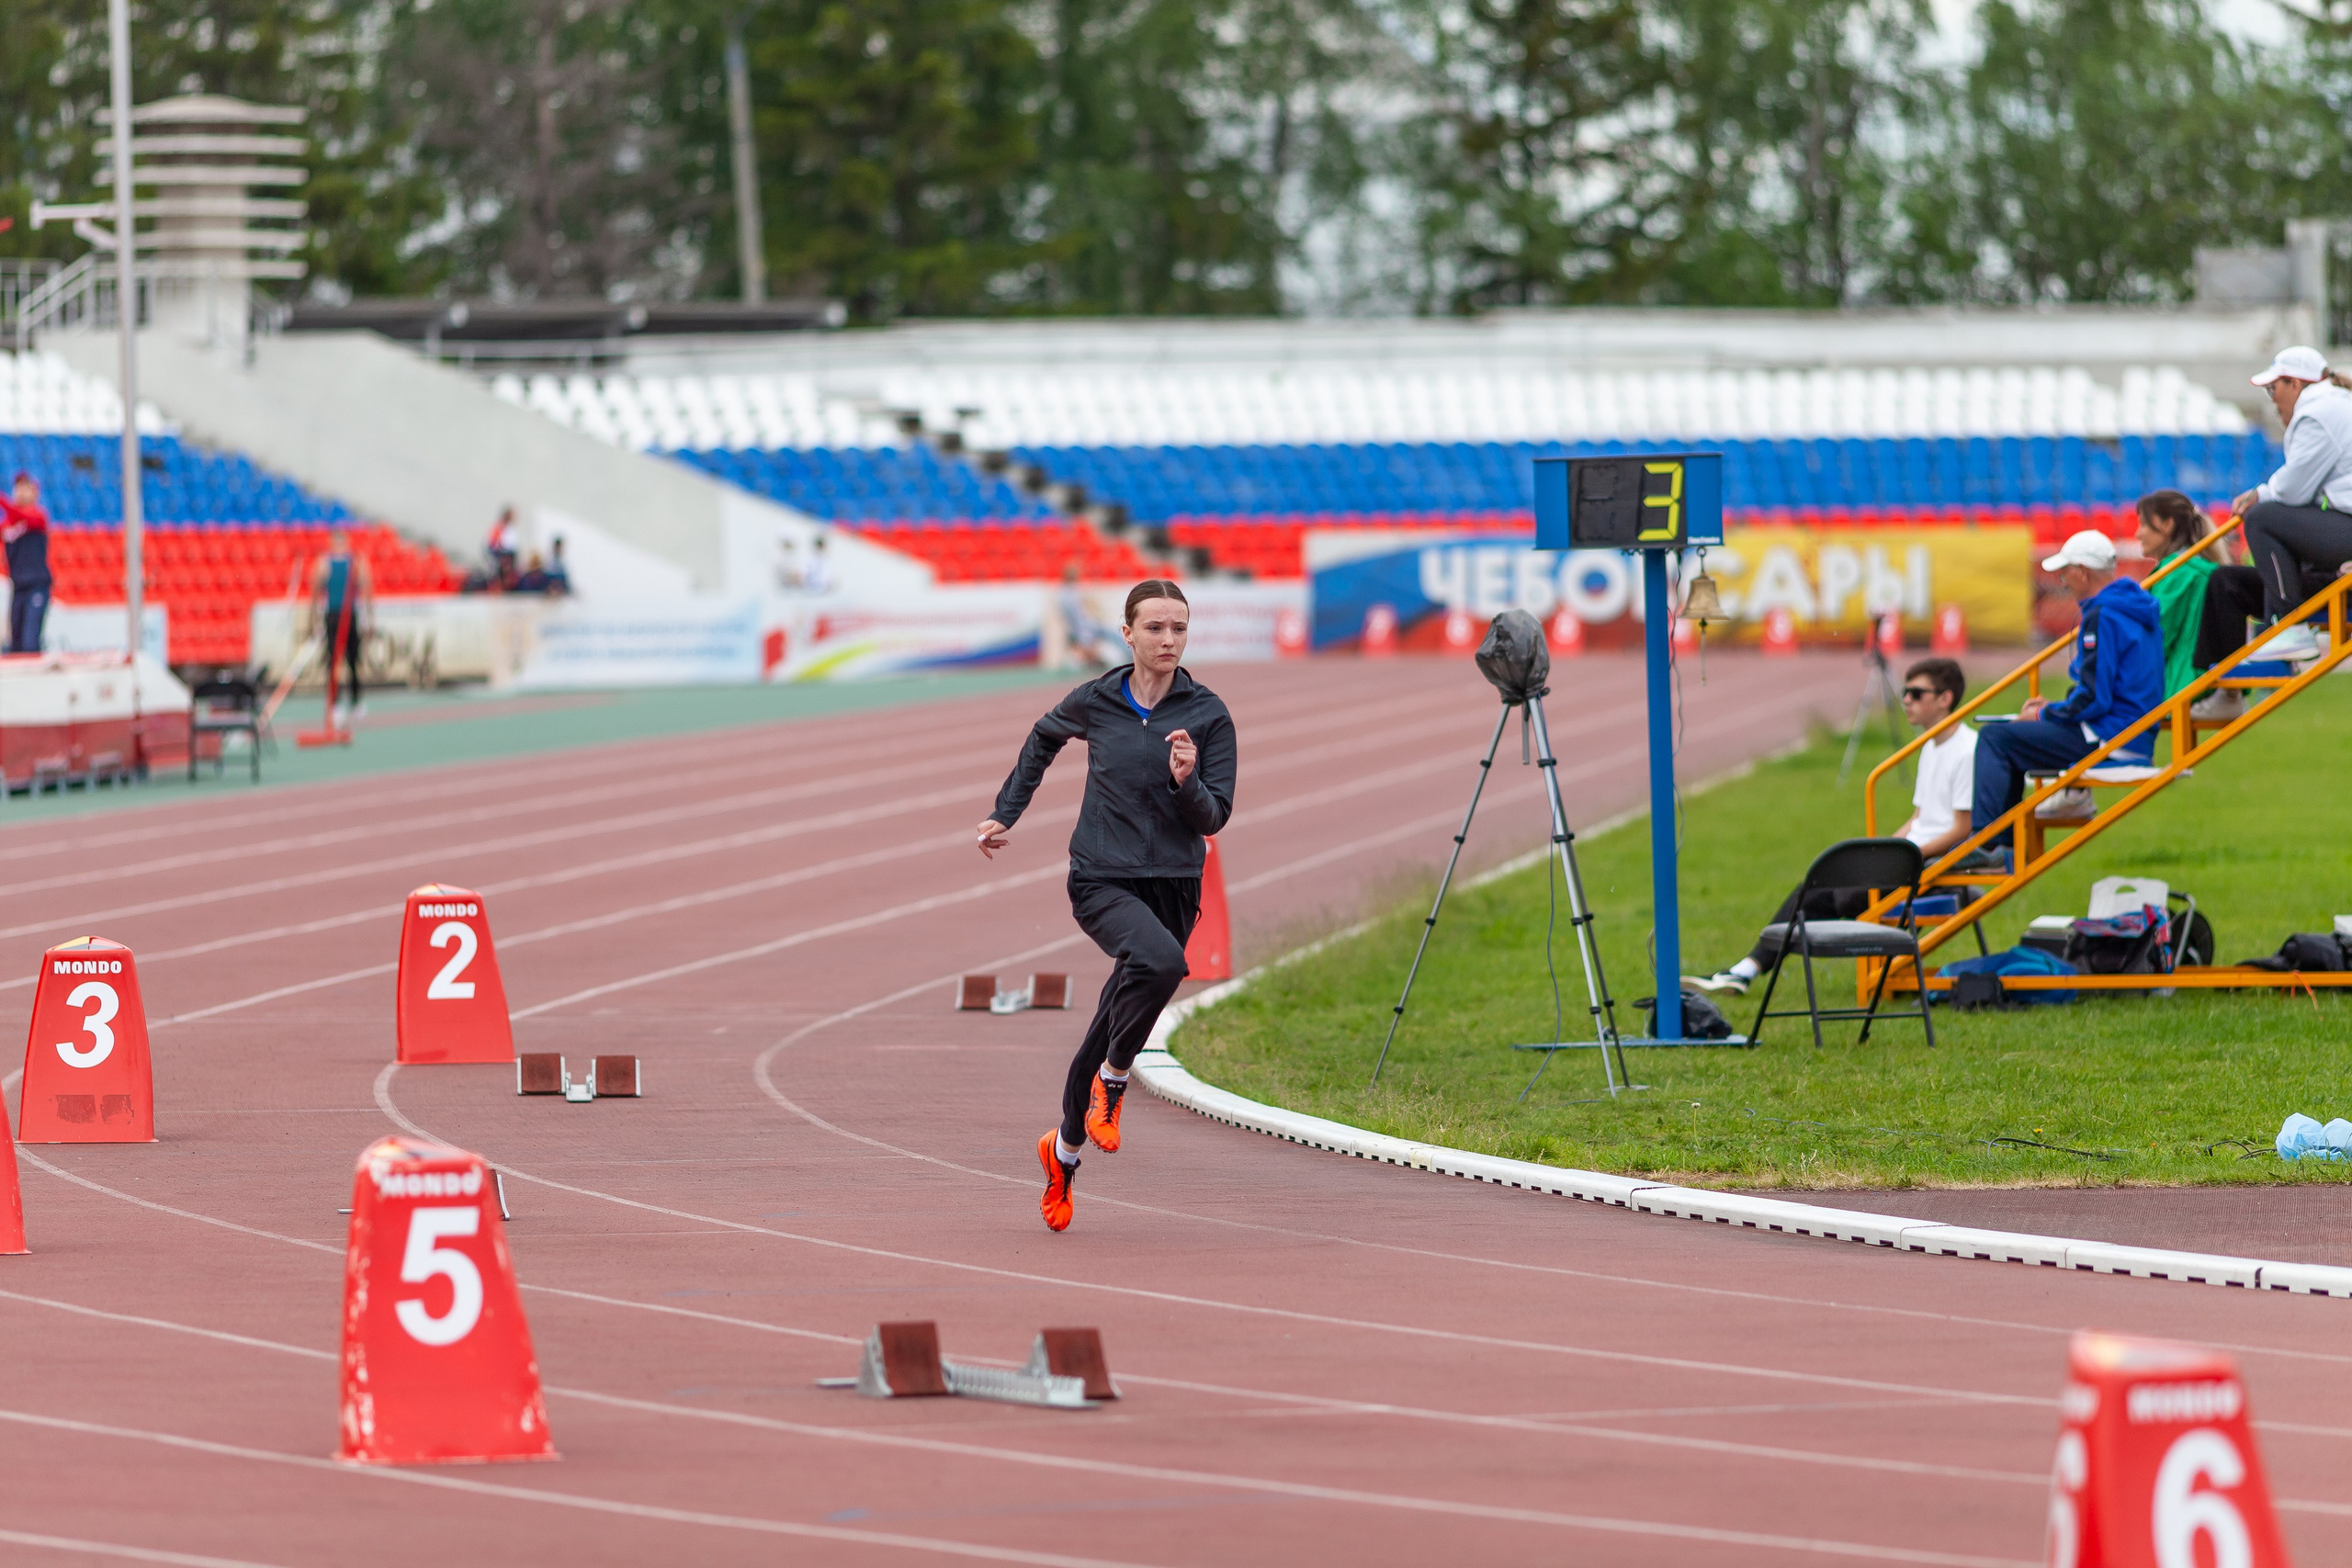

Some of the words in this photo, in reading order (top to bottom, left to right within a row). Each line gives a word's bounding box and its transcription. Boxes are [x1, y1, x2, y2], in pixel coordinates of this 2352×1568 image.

[1637, 462, 1683, 542] 3
[1419, 547, 1928, 621] ЧЕБОСАРЫ
[418, 903, 479, 918] MONDO
[53, 960, 122, 974] MONDO
[427, 921, 478, 999] 2
[55, 981, 119, 1069] 3
[379, 1170, 481, 1198] MONDO
[394, 1206, 483, 1347] 5
[2151, 1427, 2255, 1568] 6
